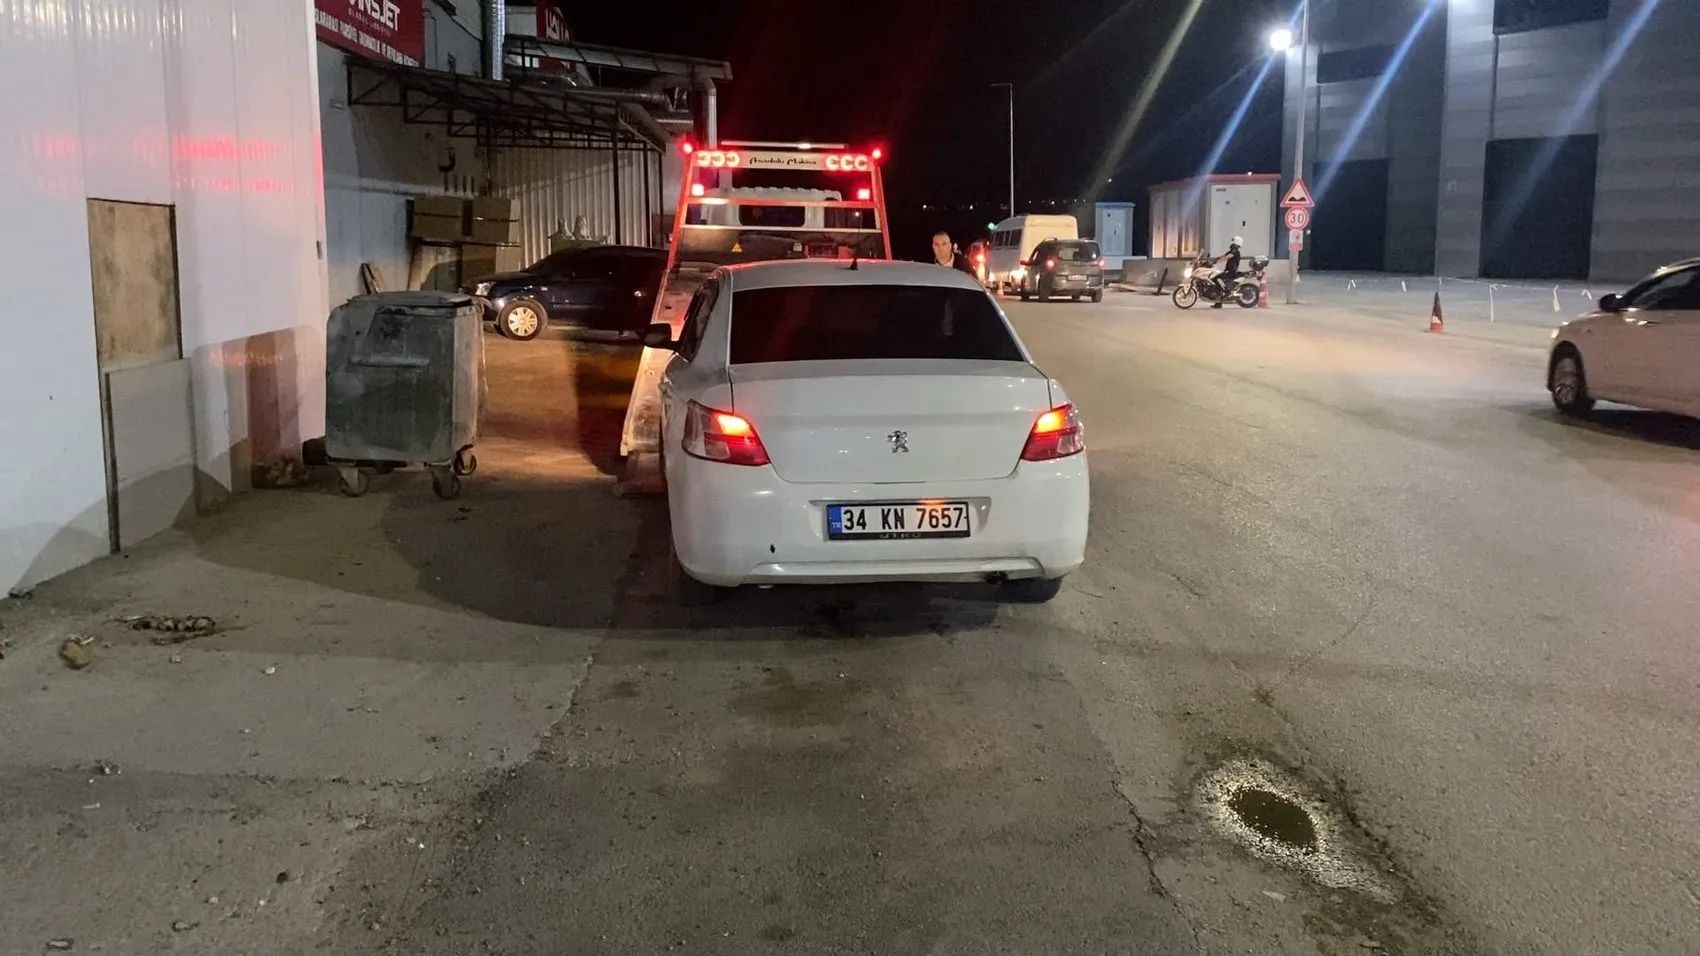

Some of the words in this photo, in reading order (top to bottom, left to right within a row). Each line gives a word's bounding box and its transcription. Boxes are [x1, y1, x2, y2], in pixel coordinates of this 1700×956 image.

[1290, 213, 1304, 224] 30
[843, 508, 866, 530] 34
[881, 508, 905, 529] KN
[916, 507, 964, 529] 7657
